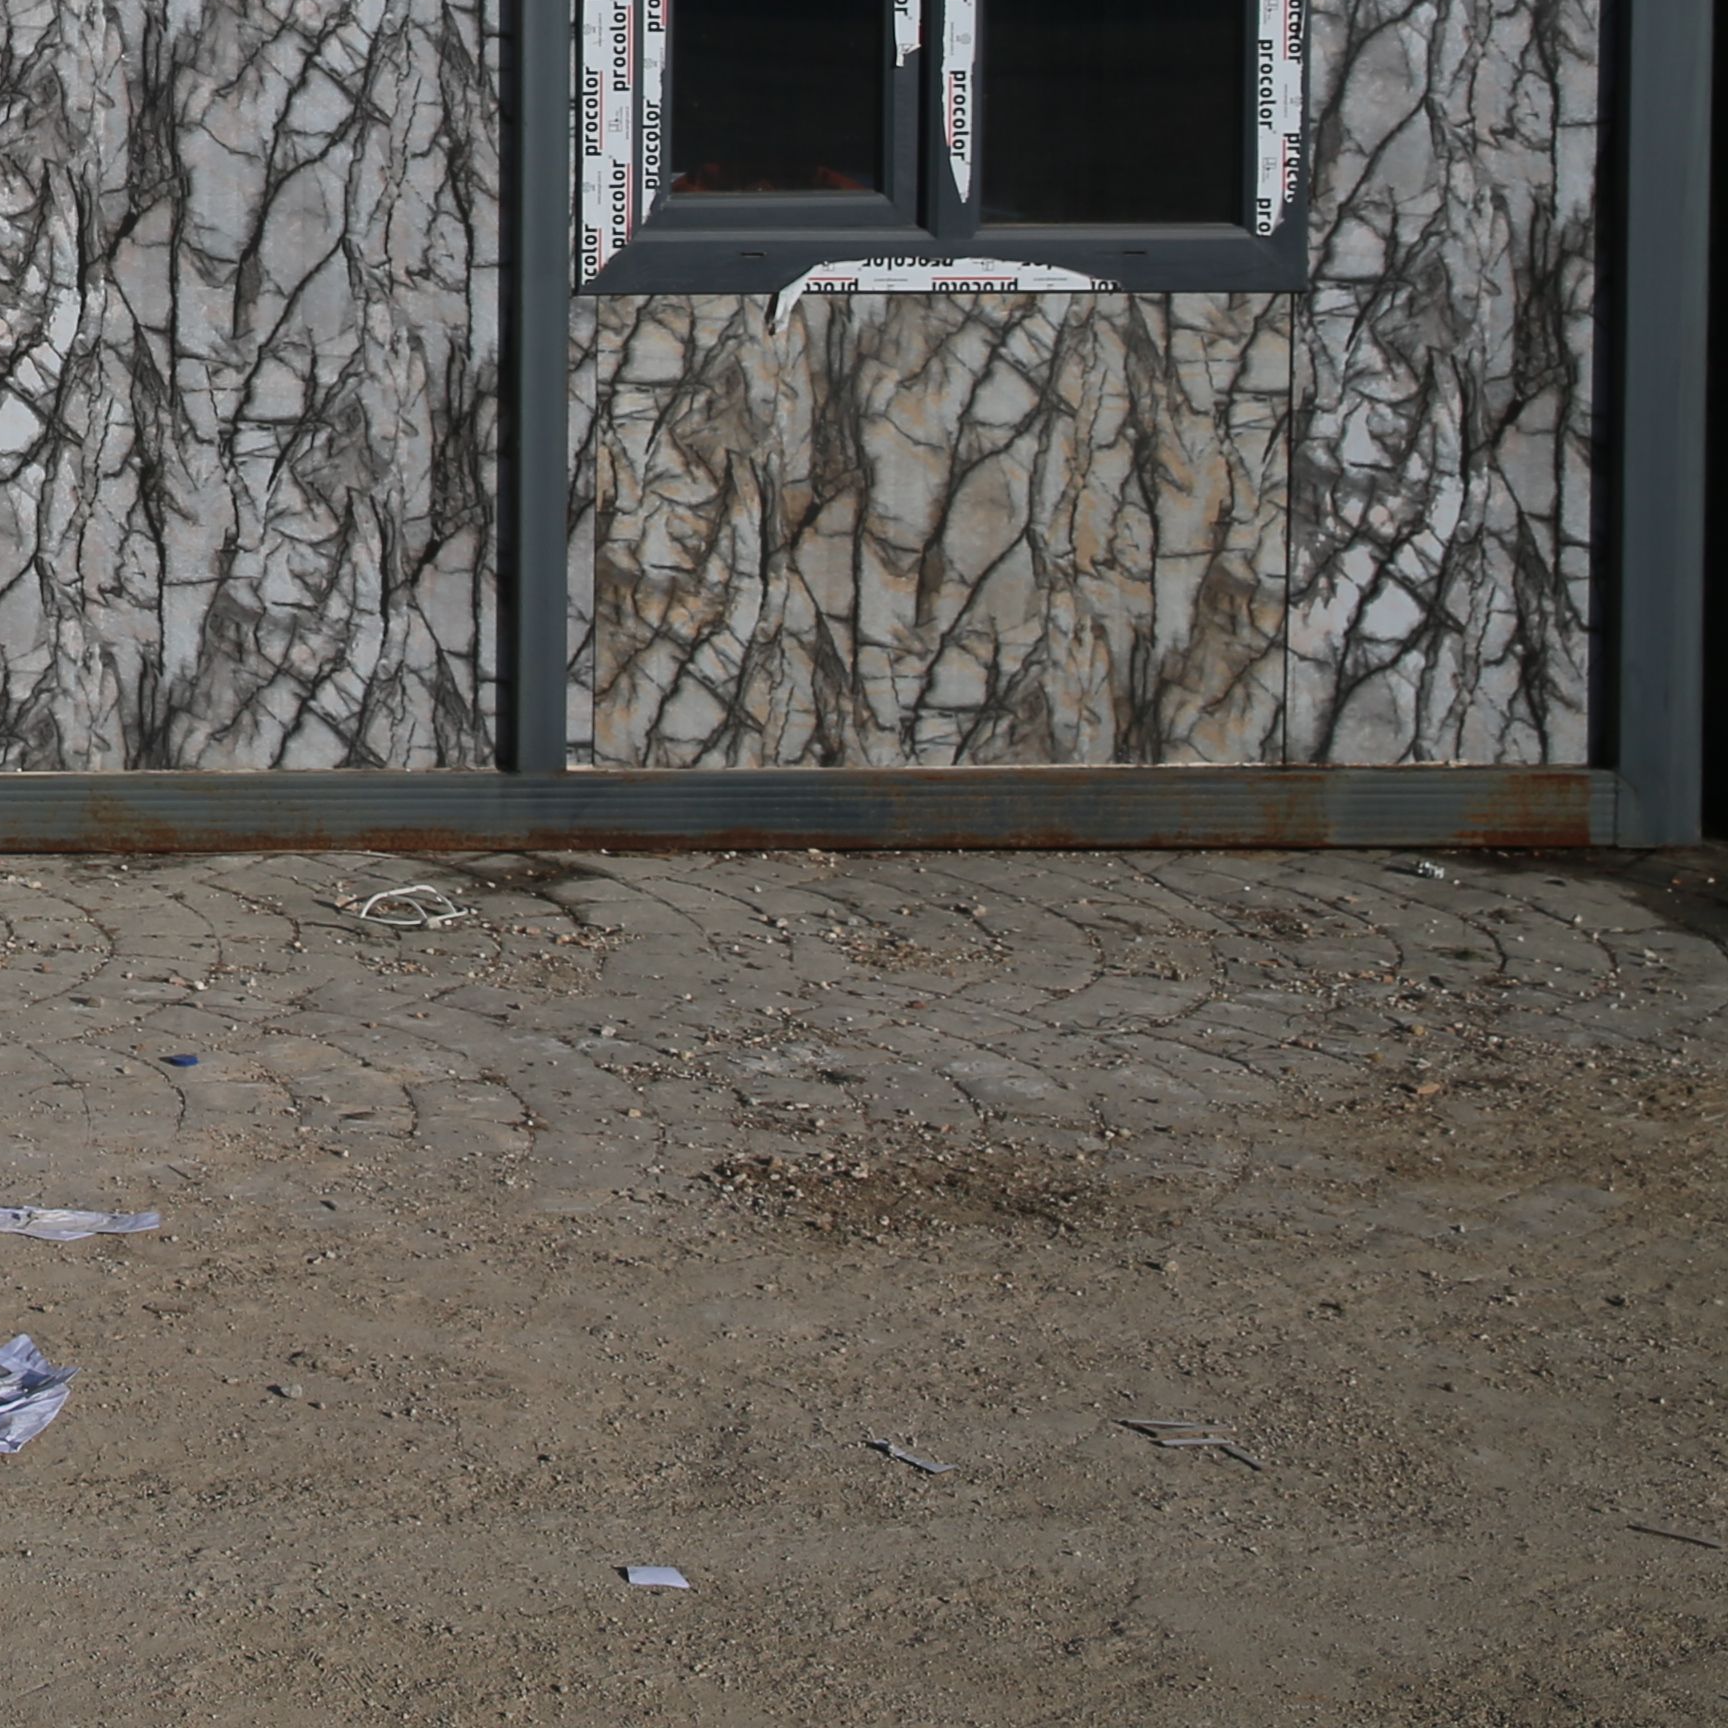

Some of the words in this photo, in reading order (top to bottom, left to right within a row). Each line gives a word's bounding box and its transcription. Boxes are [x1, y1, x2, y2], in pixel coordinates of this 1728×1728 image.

[610, 0, 630, 92] procolor
[1259, 38, 1276, 131] procolor
[583, 66, 601, 156] procolor
[643, 99, 660, 190] procolor
[950, 70, 969, 161] procolor
[609, 159, 627, 250] procolor
